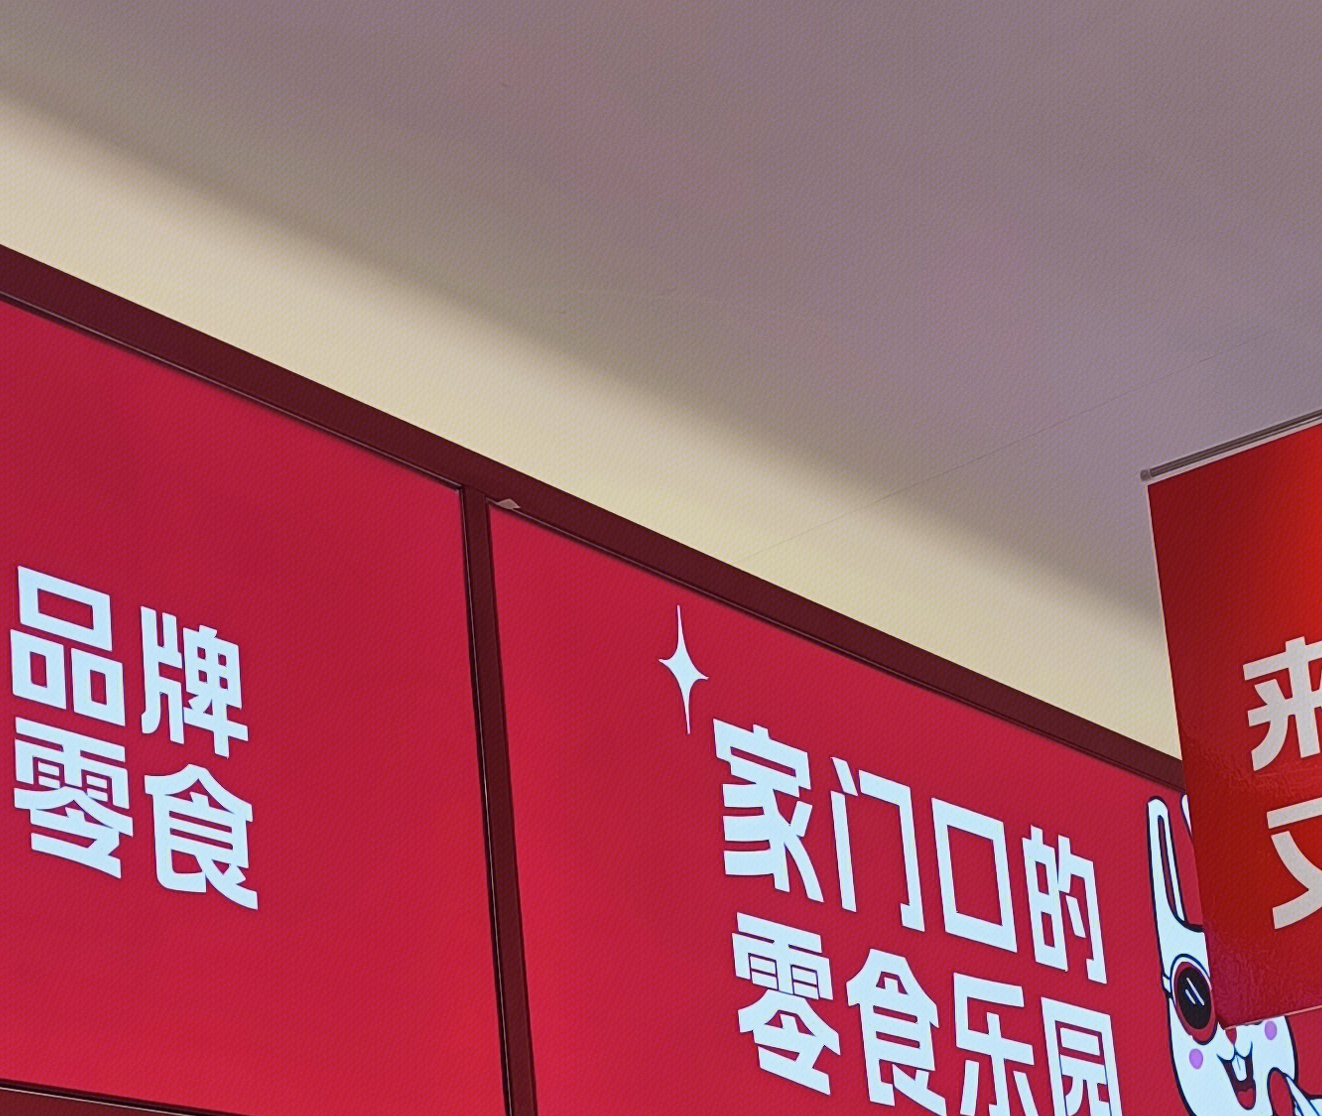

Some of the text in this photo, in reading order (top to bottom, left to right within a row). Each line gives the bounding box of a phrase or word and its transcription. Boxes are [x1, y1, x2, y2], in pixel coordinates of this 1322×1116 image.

[9, 565, 250, 757] 品牌
[12, 720, 260, 911] 零食
[713, 718, 1108, 985] 家门口的
